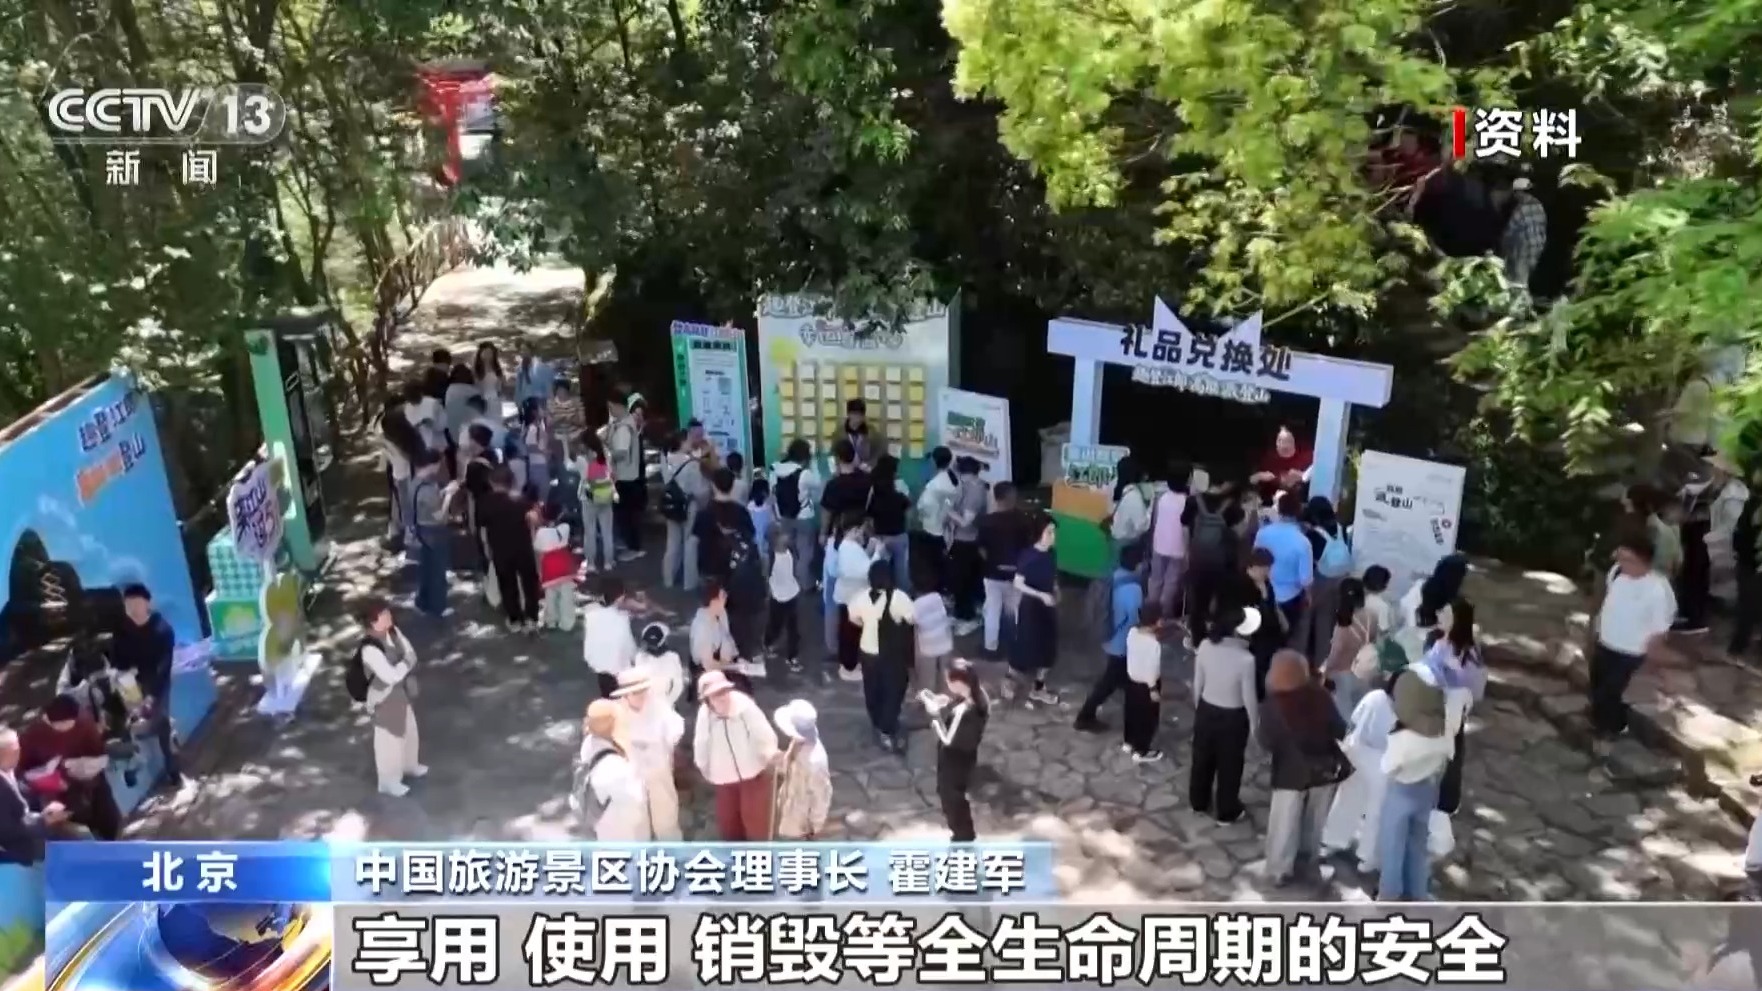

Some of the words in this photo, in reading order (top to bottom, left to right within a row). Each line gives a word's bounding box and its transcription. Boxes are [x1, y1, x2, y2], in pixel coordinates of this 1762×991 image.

[1120, 324, 1292, 381] 礼品兑换处
